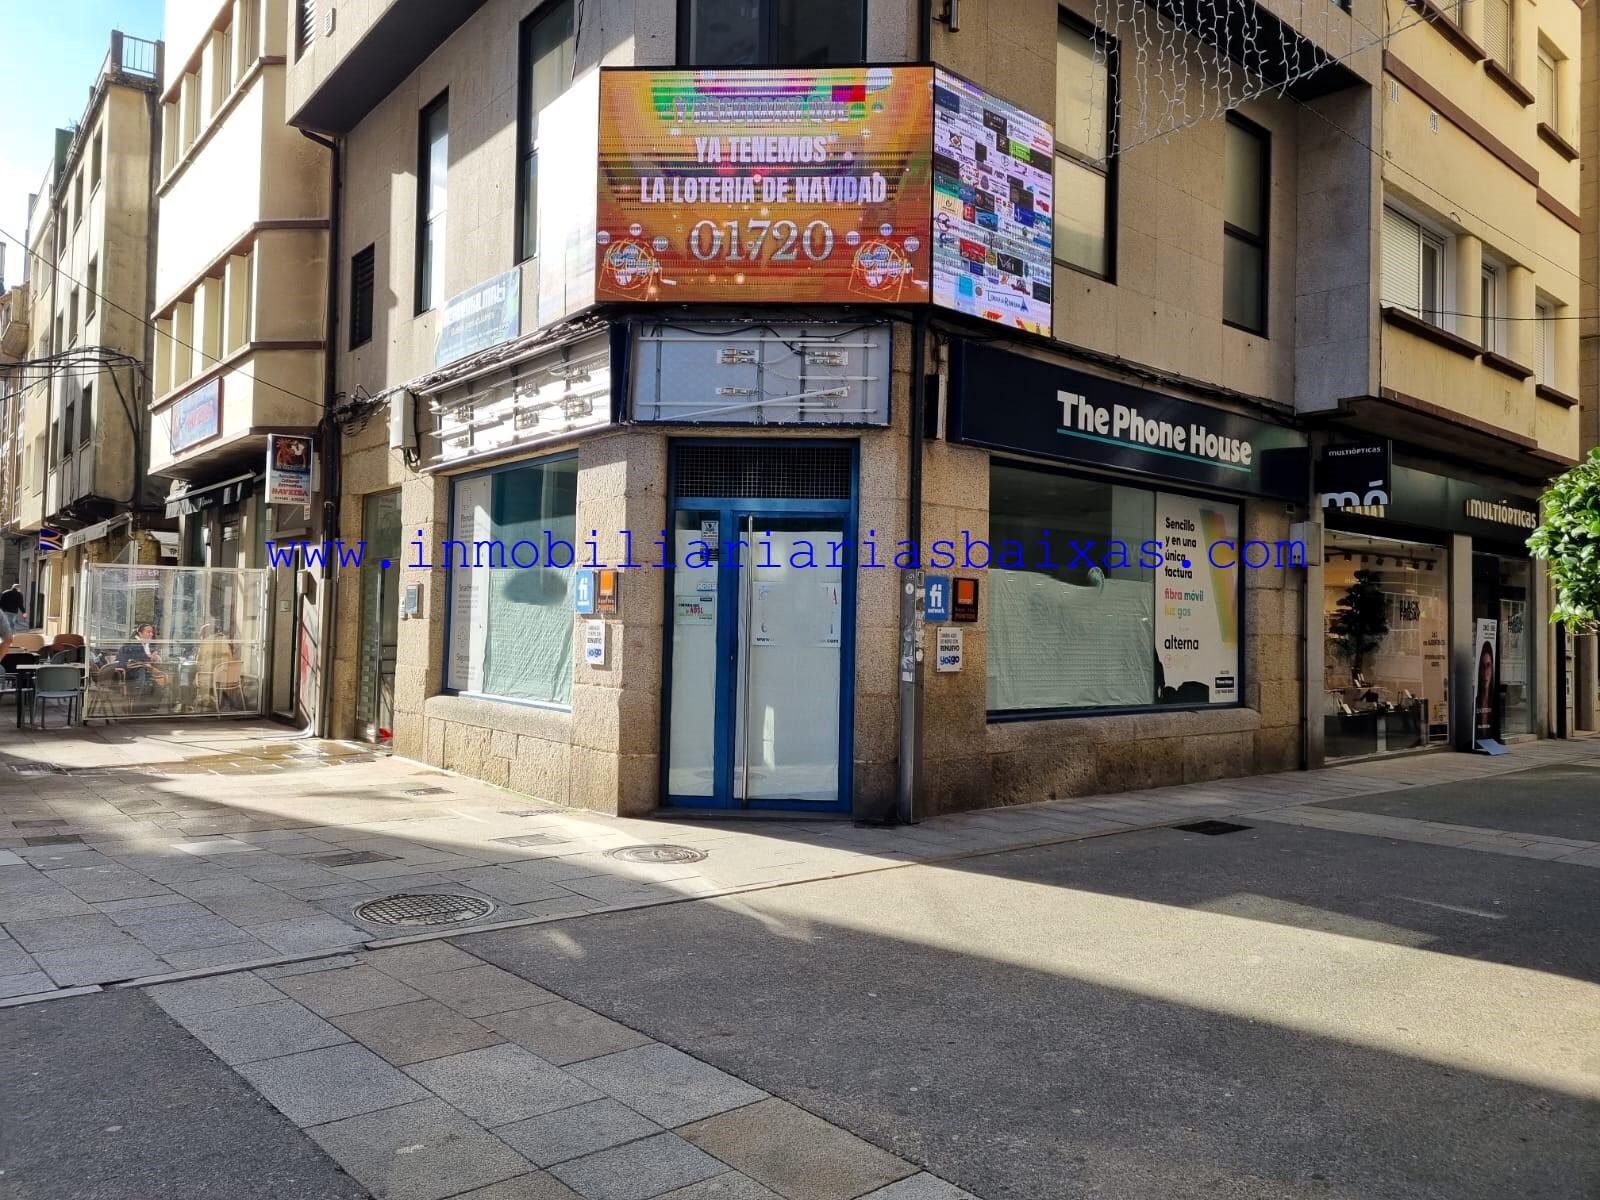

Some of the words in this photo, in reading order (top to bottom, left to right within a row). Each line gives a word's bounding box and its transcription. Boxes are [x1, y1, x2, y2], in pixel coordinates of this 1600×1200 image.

[695, 136, 722, 163] YA
[729, 136, 827, 163] TENEMOS
[640, 176, 666, 203] LA
[673, 176, 755, 203] LOTERIA
[762, 176, 789, 203] DE
[795, 174, 888, 203] NAVIDAD
[690, 218, 835, 261] 01720
[1057, 390, 1110, 435] The
[1113, 404, 1187, 452] Phone
[1190, 423, 1252, 465] House
[1165, 517, 1195, 532] Sencillo
[1165, 536, 1170, 547] y
[1171, 537, 1182, 546] en
[1182, 539, 1197, 548] una
[1165, 550, 1187, 562] única
[1165, 567, 1193, 580] factura
[929, 584, 943, 608] fi
[1164, 588, 1183, 601] fibra
[1184, 589, 1204, 602] móvil
[1164, 603, 1176, 617] luz
[1177, 607, 1191, 619] gas
[1164, 635, 1199, 650] alterna
[939, 655, 960, 666] yoigo
